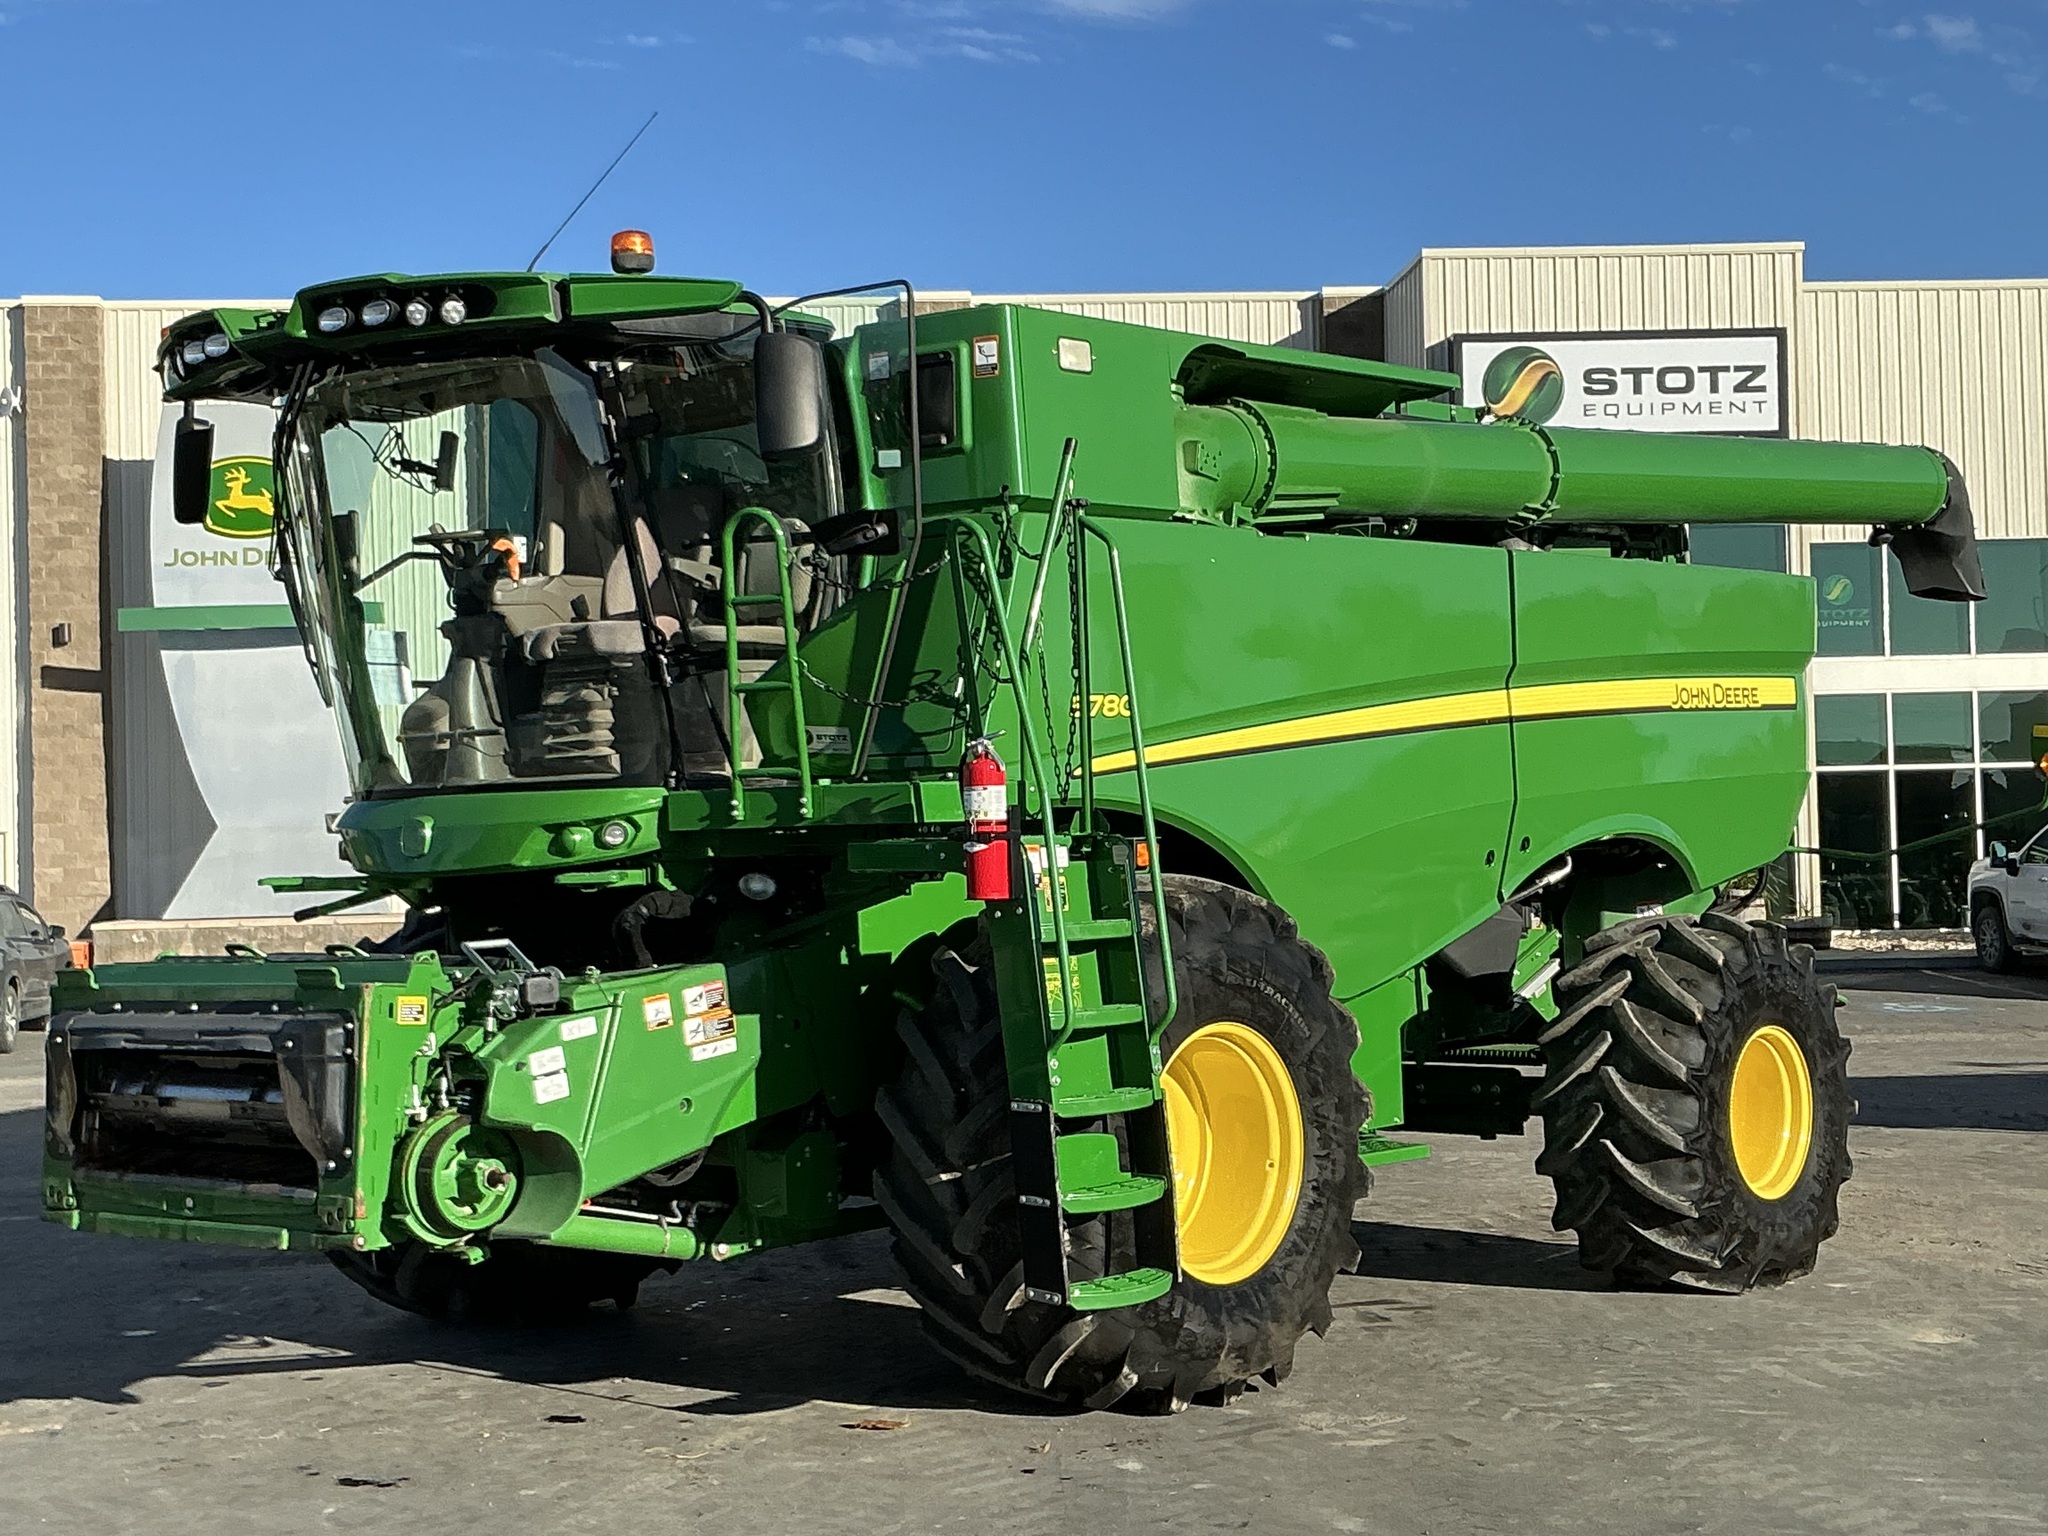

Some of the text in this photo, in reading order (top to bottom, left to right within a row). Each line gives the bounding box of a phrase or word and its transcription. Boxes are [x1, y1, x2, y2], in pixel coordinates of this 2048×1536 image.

[1582, 364, 1768, 396] STOTZ
[1583, 400, 1768, 419] EQUIPMENT
[163, 547, 238, 567] JOHN
[1817, 619, 1871, 628] UIPMENT
[1818, 608, 1870, 620] TOTZ
[1671, 682, 1760, 705] JOHN DEERE
